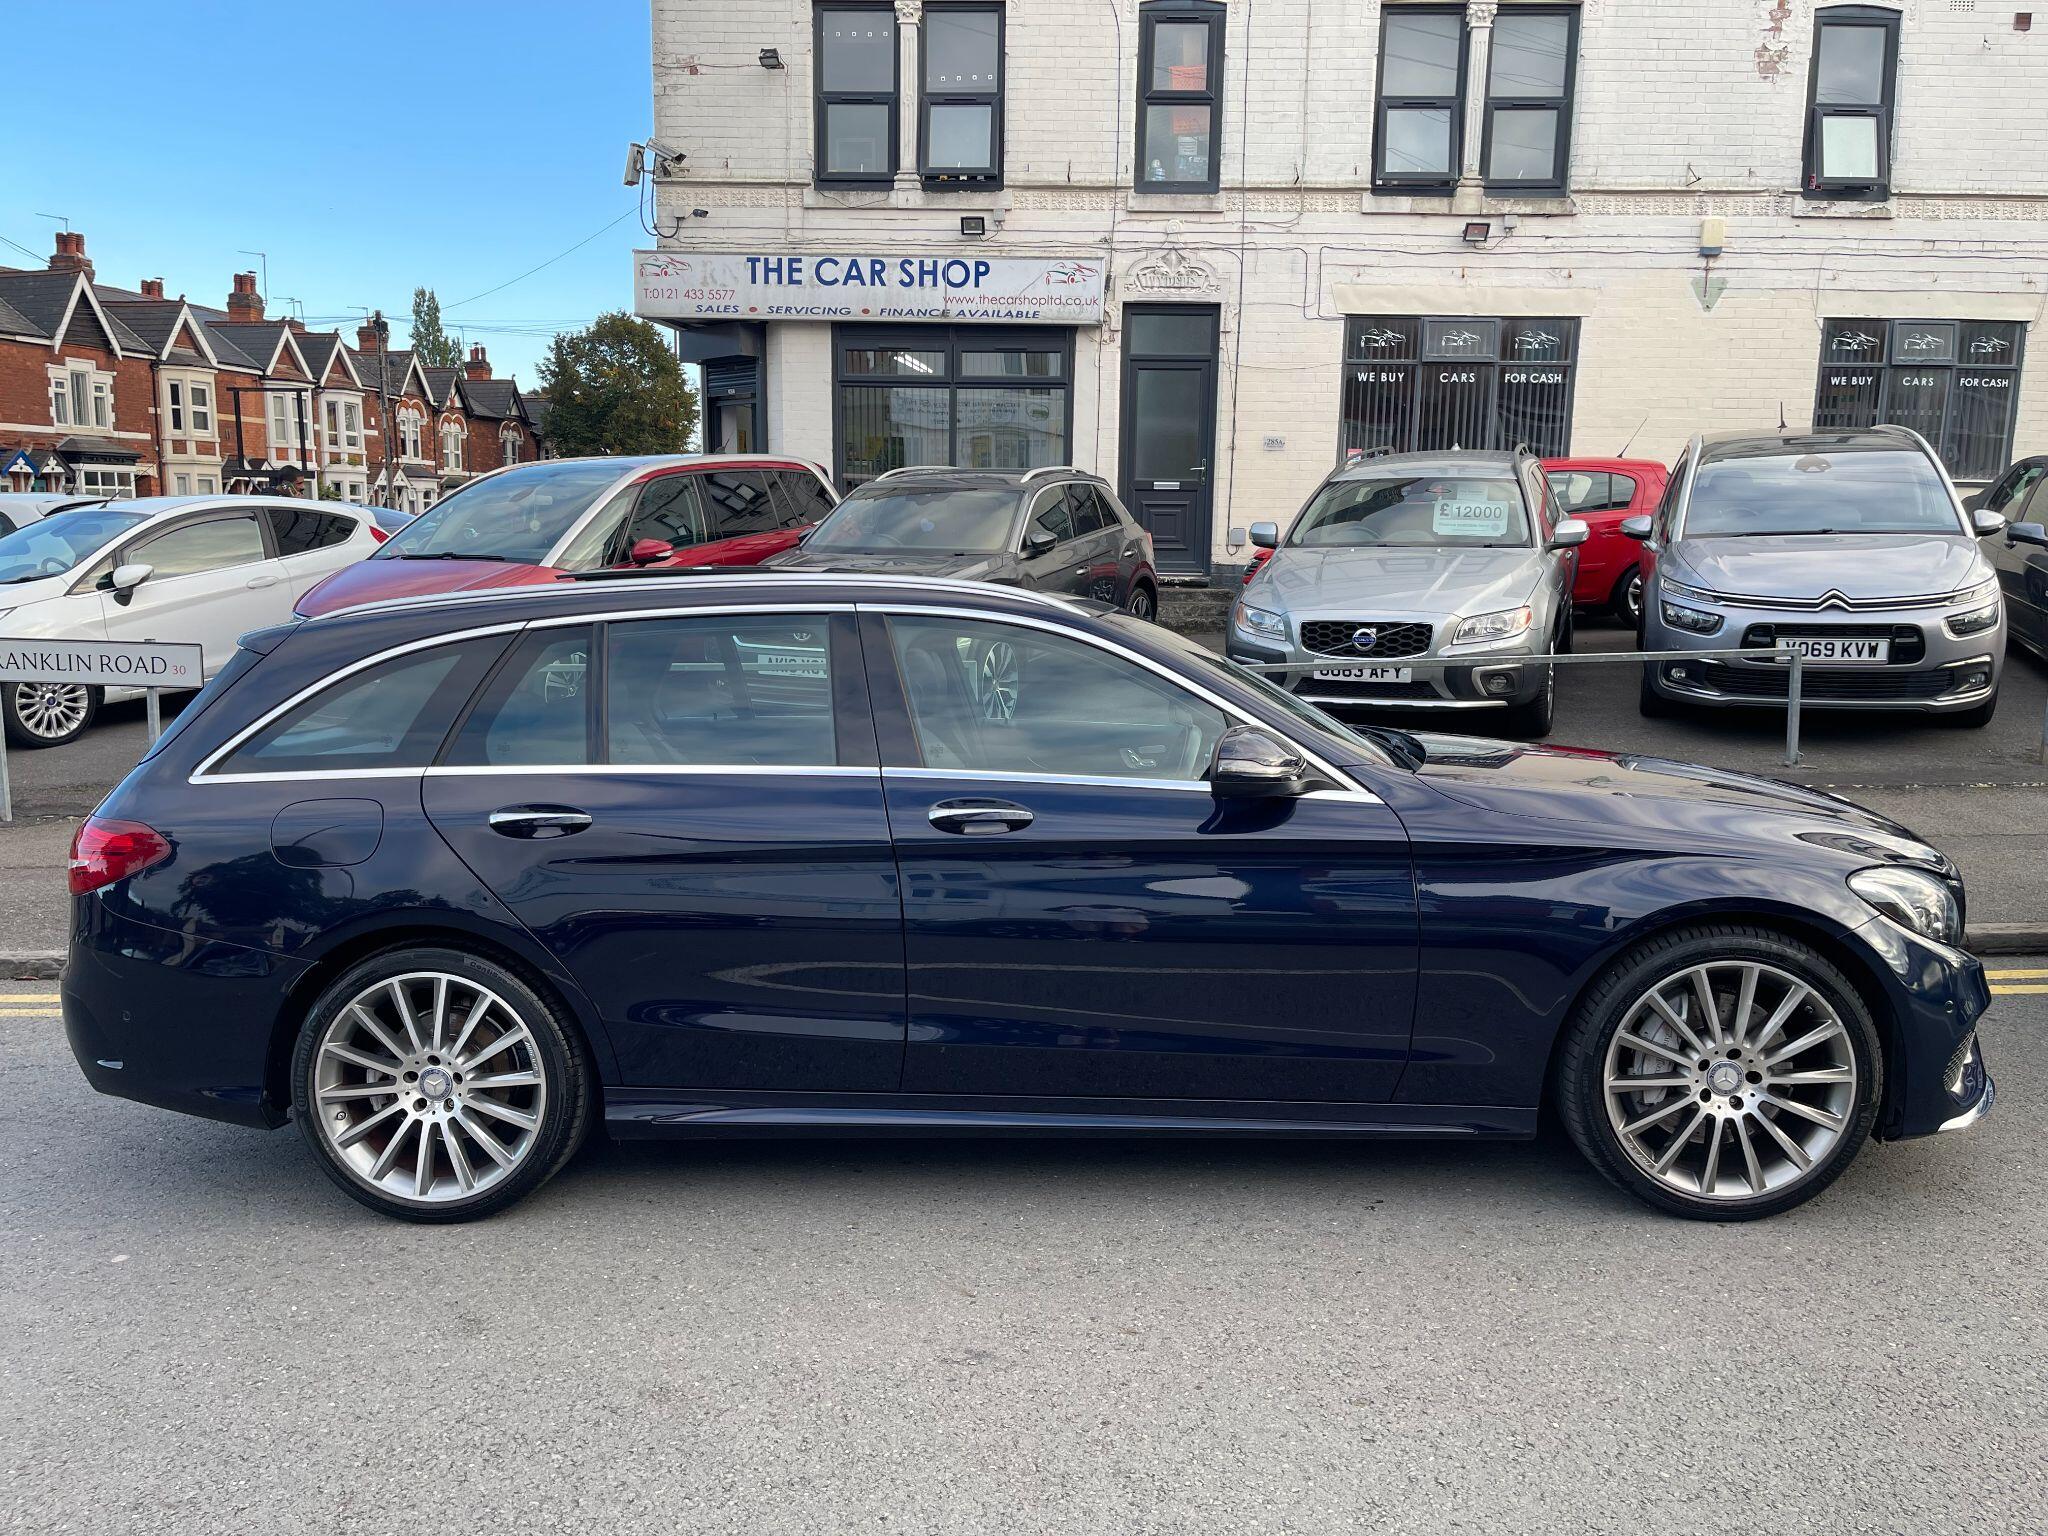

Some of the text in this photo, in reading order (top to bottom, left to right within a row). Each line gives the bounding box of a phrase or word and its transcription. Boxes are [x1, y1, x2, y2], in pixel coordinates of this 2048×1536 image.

[746, 257, 991, 289] THE CAR SHOP
[643, 288, 736, 301] T:0121 433 5577
[942, 293, 1100, 308] www.thecarshopltd.co.uk
[695, 304, 1041, 319] SALES SERVICING FINANCE AVAILABLE
[1357, 372, 1405, 383] WE BUY
[1439, 372, 1476, 383] CARS
[1504, 373, 1562, 384] FOR CASH
[1830, 376, 1874, 386] WE BUY
[1902, 376, 1935, 387] CARS
[1959, 377, 2009, 388] FOR CASH
[1439, 502, 1503, 519] £12000
[1840, 642, 1879, 659] KVW
[99, 655, 168, 675] ROAD
[172, 665, 187, 676] 30
